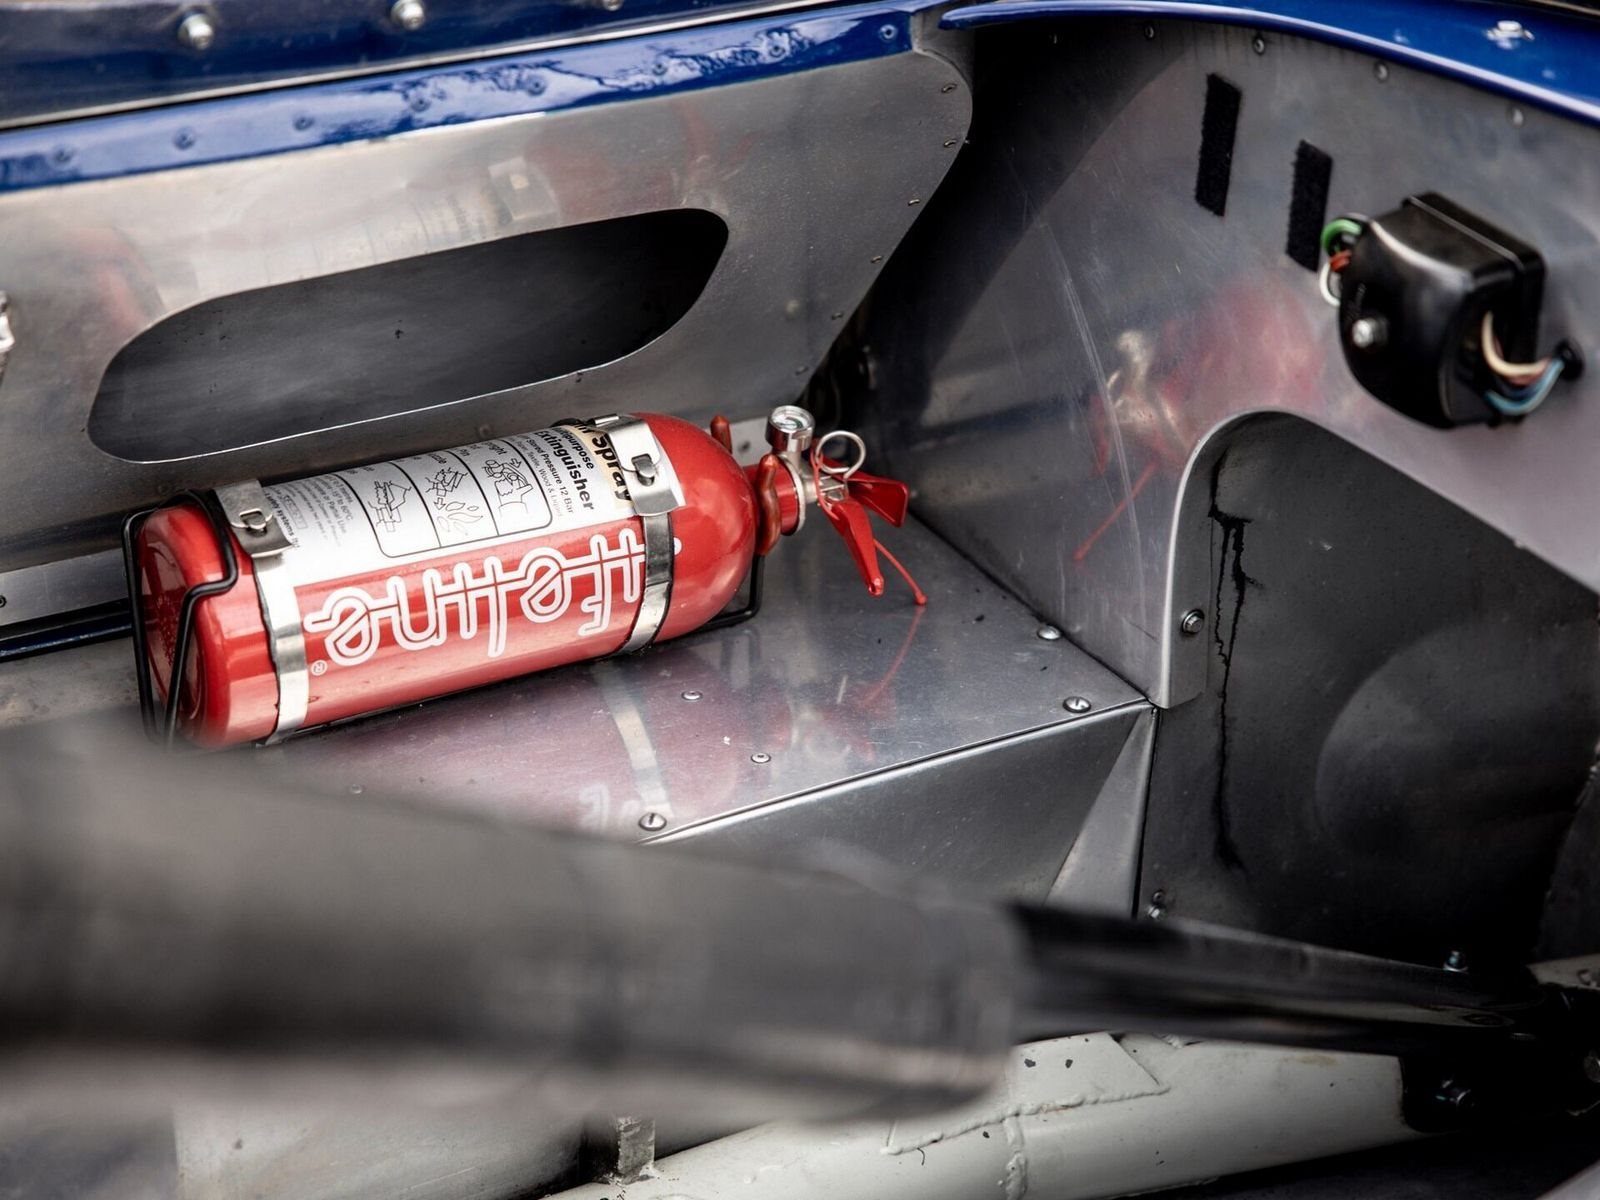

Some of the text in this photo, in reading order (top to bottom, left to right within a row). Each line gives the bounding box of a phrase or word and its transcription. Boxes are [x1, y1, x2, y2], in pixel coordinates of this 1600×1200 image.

[533, 430, 595, 510] Extinguisher
[539, 468, 552, 487] Wood
[540, 452, 562, 484] Pressure
[559, 485, 569, 496] 12
[563, 496, 574, 513] Bar
[276, 509, 295, 536] systems
